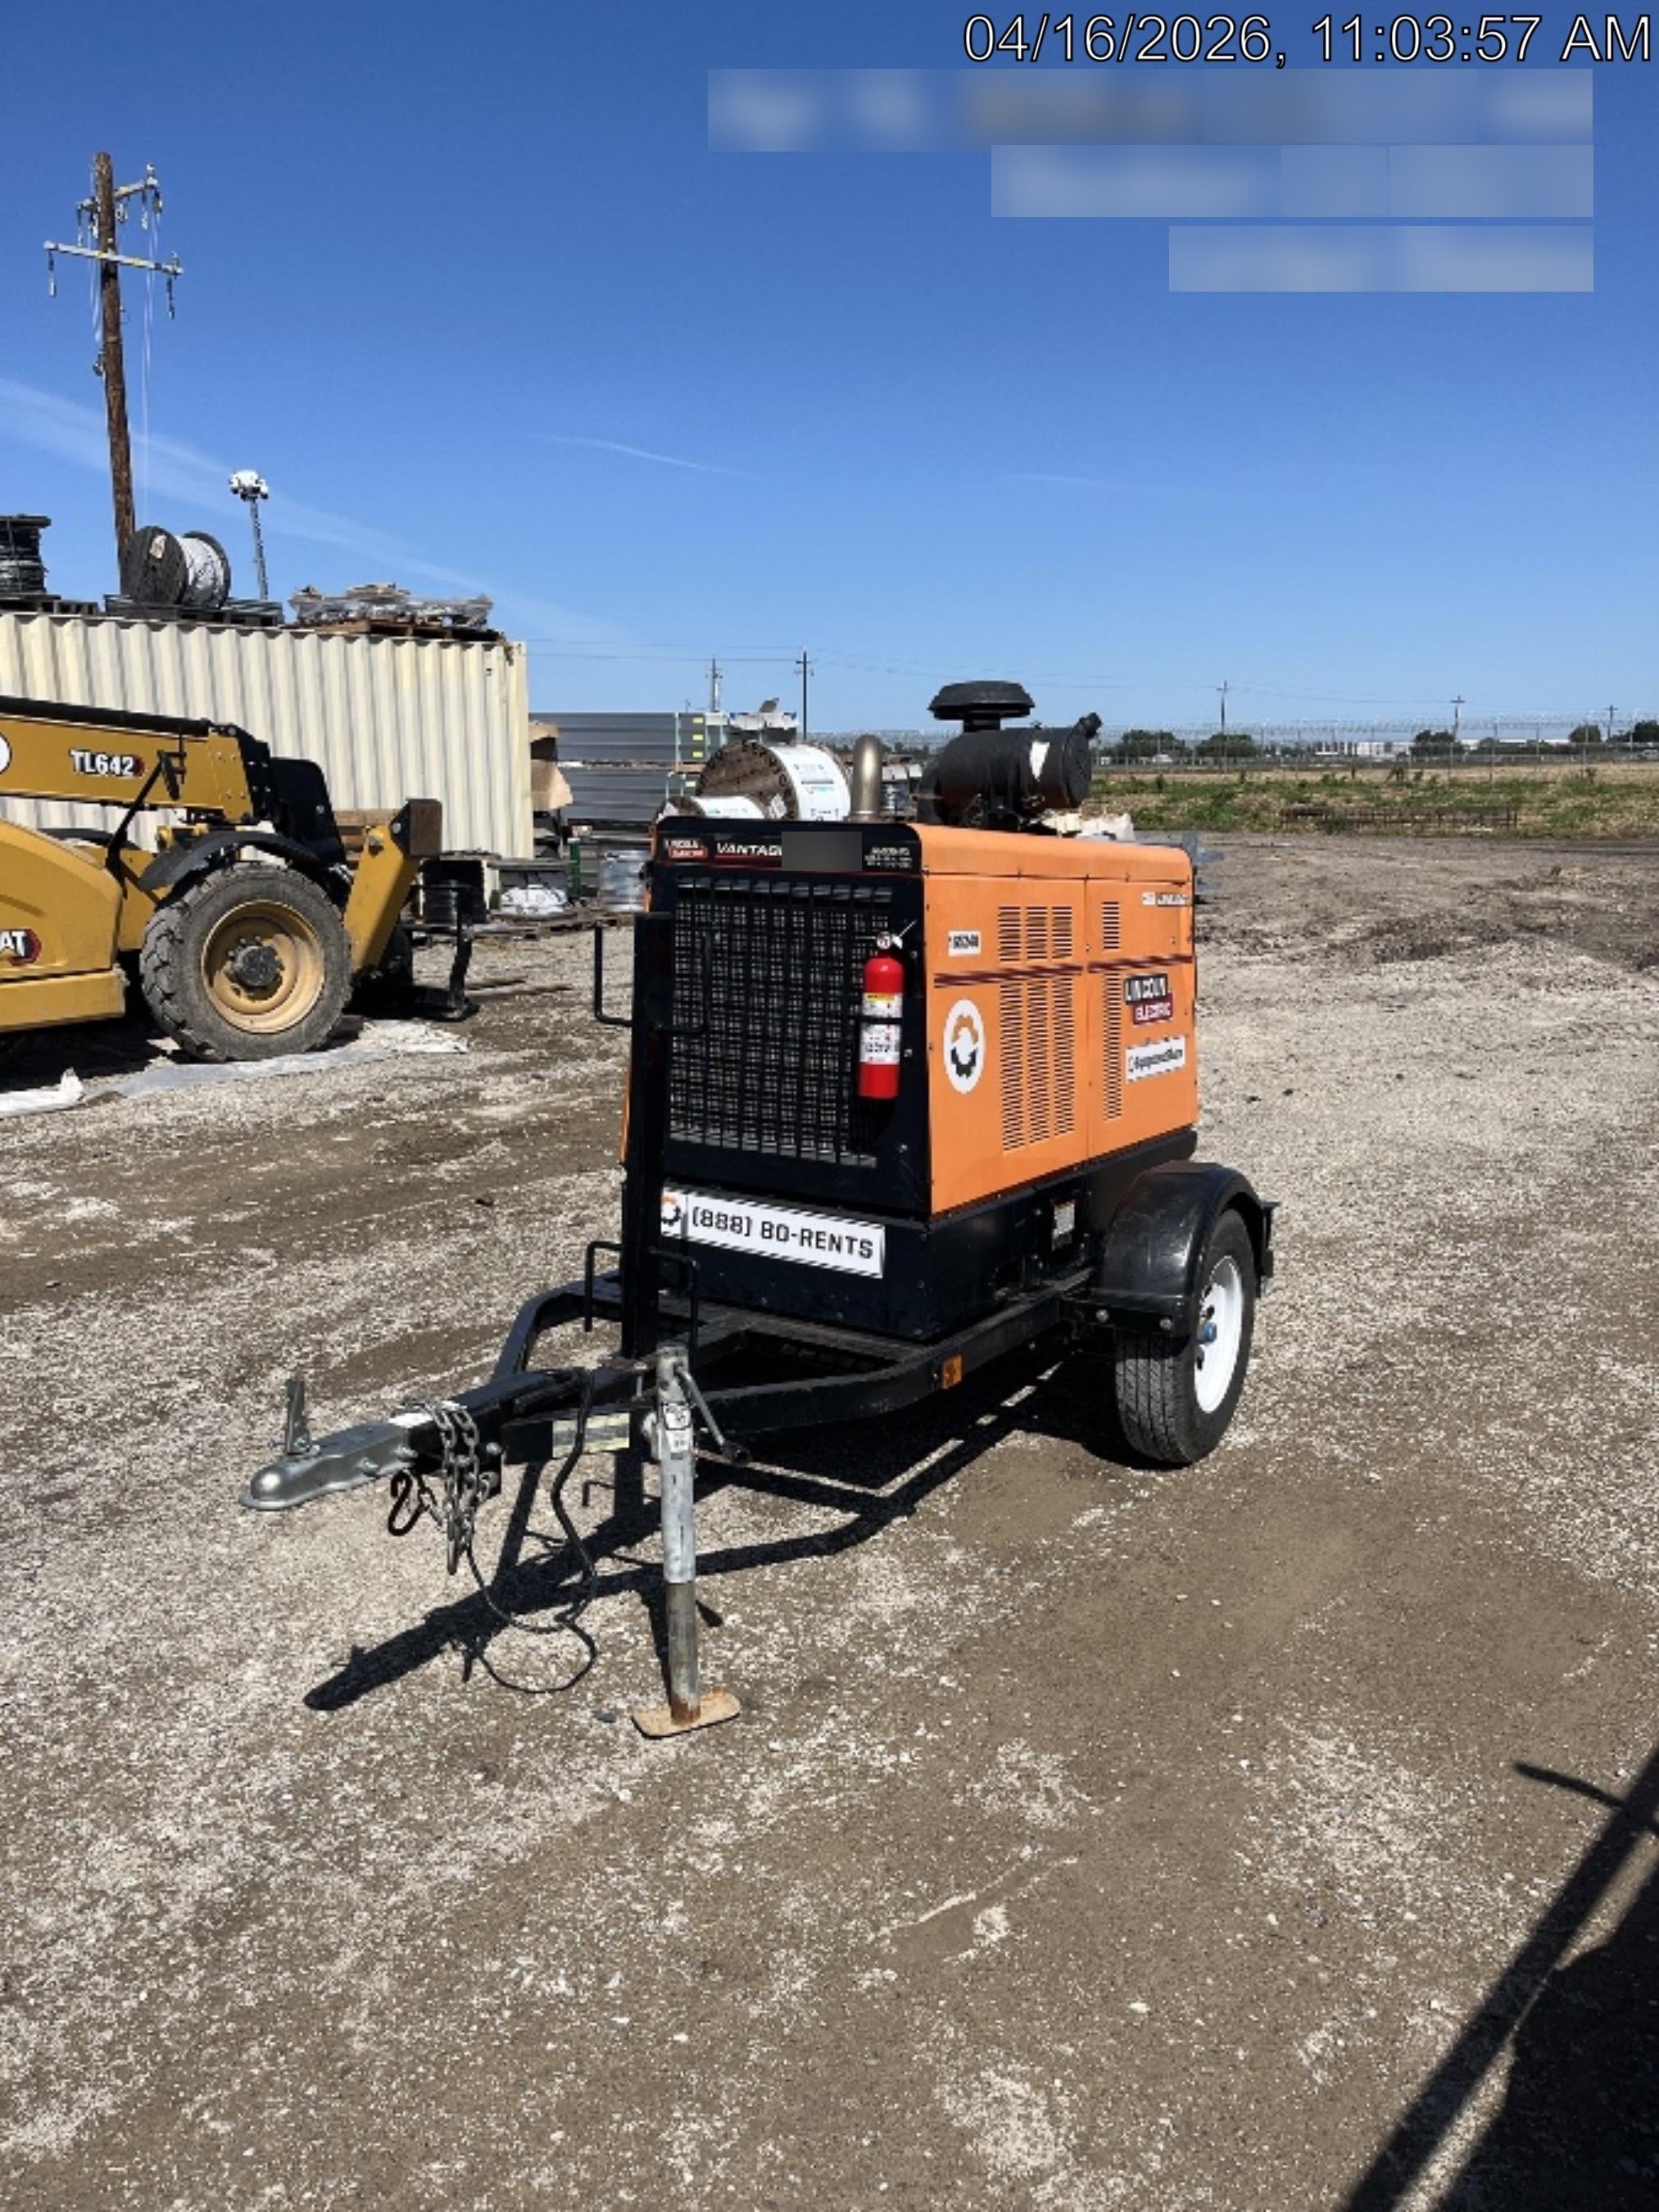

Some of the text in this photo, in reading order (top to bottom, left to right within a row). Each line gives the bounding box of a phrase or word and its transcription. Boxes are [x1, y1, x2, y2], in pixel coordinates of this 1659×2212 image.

[70, 749, 134, 776] TL642
[716, 842, 782, 856] VANTAG
[0, 931, 25, 957] AT
